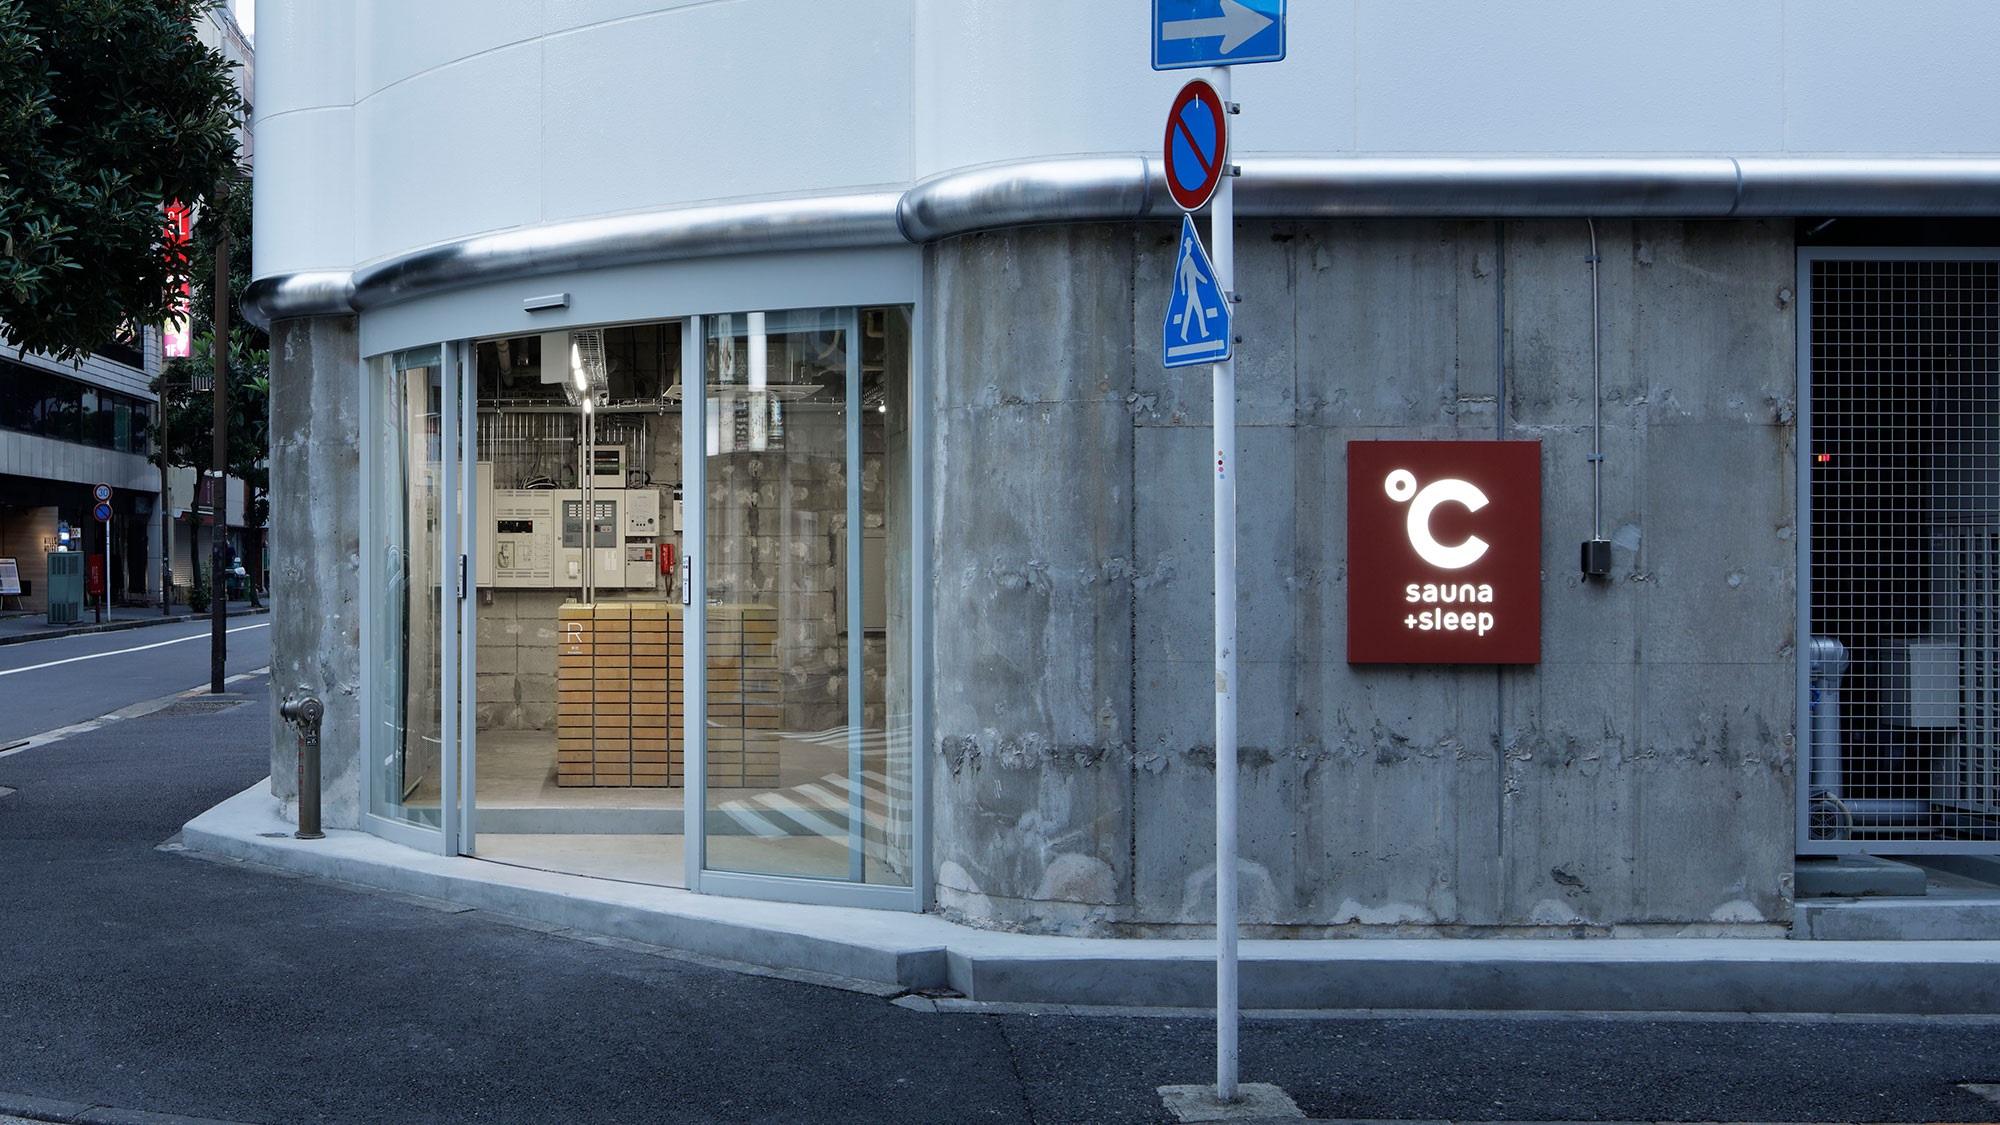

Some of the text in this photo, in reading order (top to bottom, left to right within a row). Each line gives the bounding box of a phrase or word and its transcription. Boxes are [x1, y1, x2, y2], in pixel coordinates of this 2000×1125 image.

[165, 344, 176, 356] 1F
[98, 488, 108, 497] 30
[1405, 583, 1493, 603] sauna
[1404, 608, 1494, 636] +sleep
[567, 622, 583, 643] R
